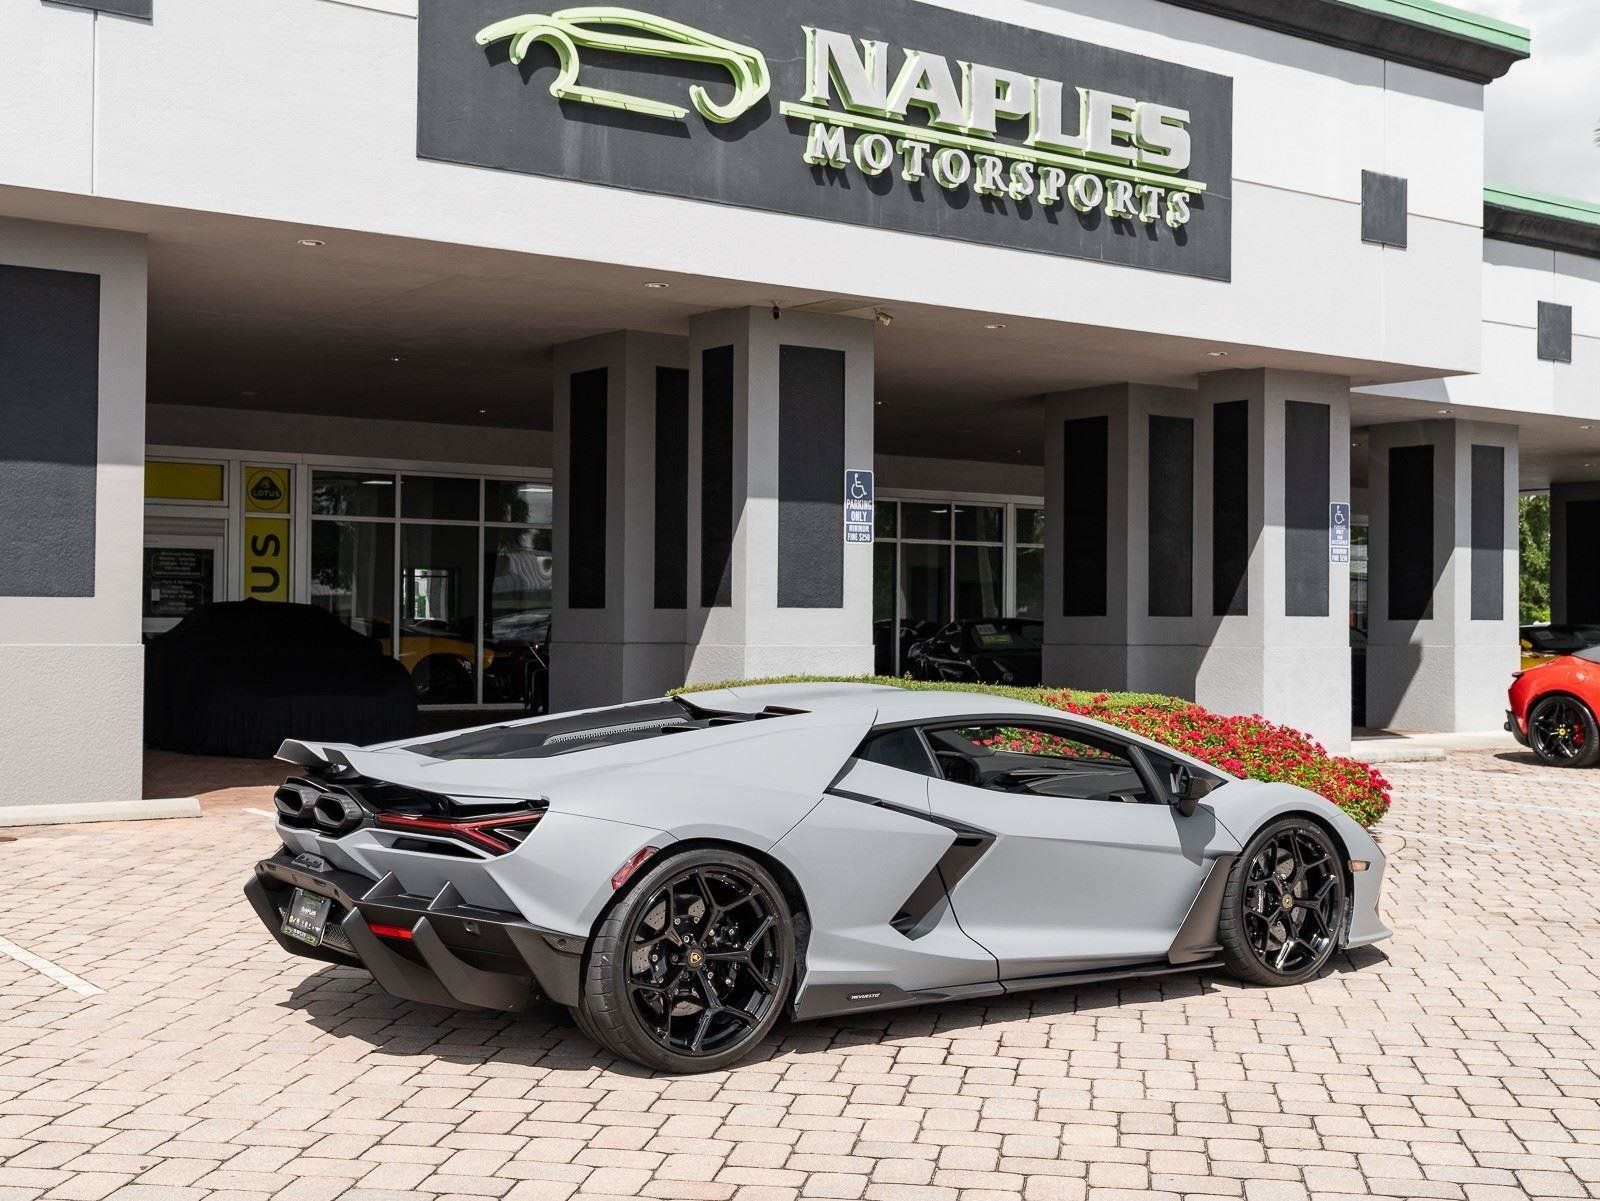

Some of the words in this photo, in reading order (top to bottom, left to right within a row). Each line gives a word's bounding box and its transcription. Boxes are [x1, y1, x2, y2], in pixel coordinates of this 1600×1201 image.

[801, 25, 1191, 173] NAPLES
[803, 123, 1190, 228] MOTORSPORTS
[847, 499, 871, 510] PARKING
[850, 511, 867, 521] ONLY
